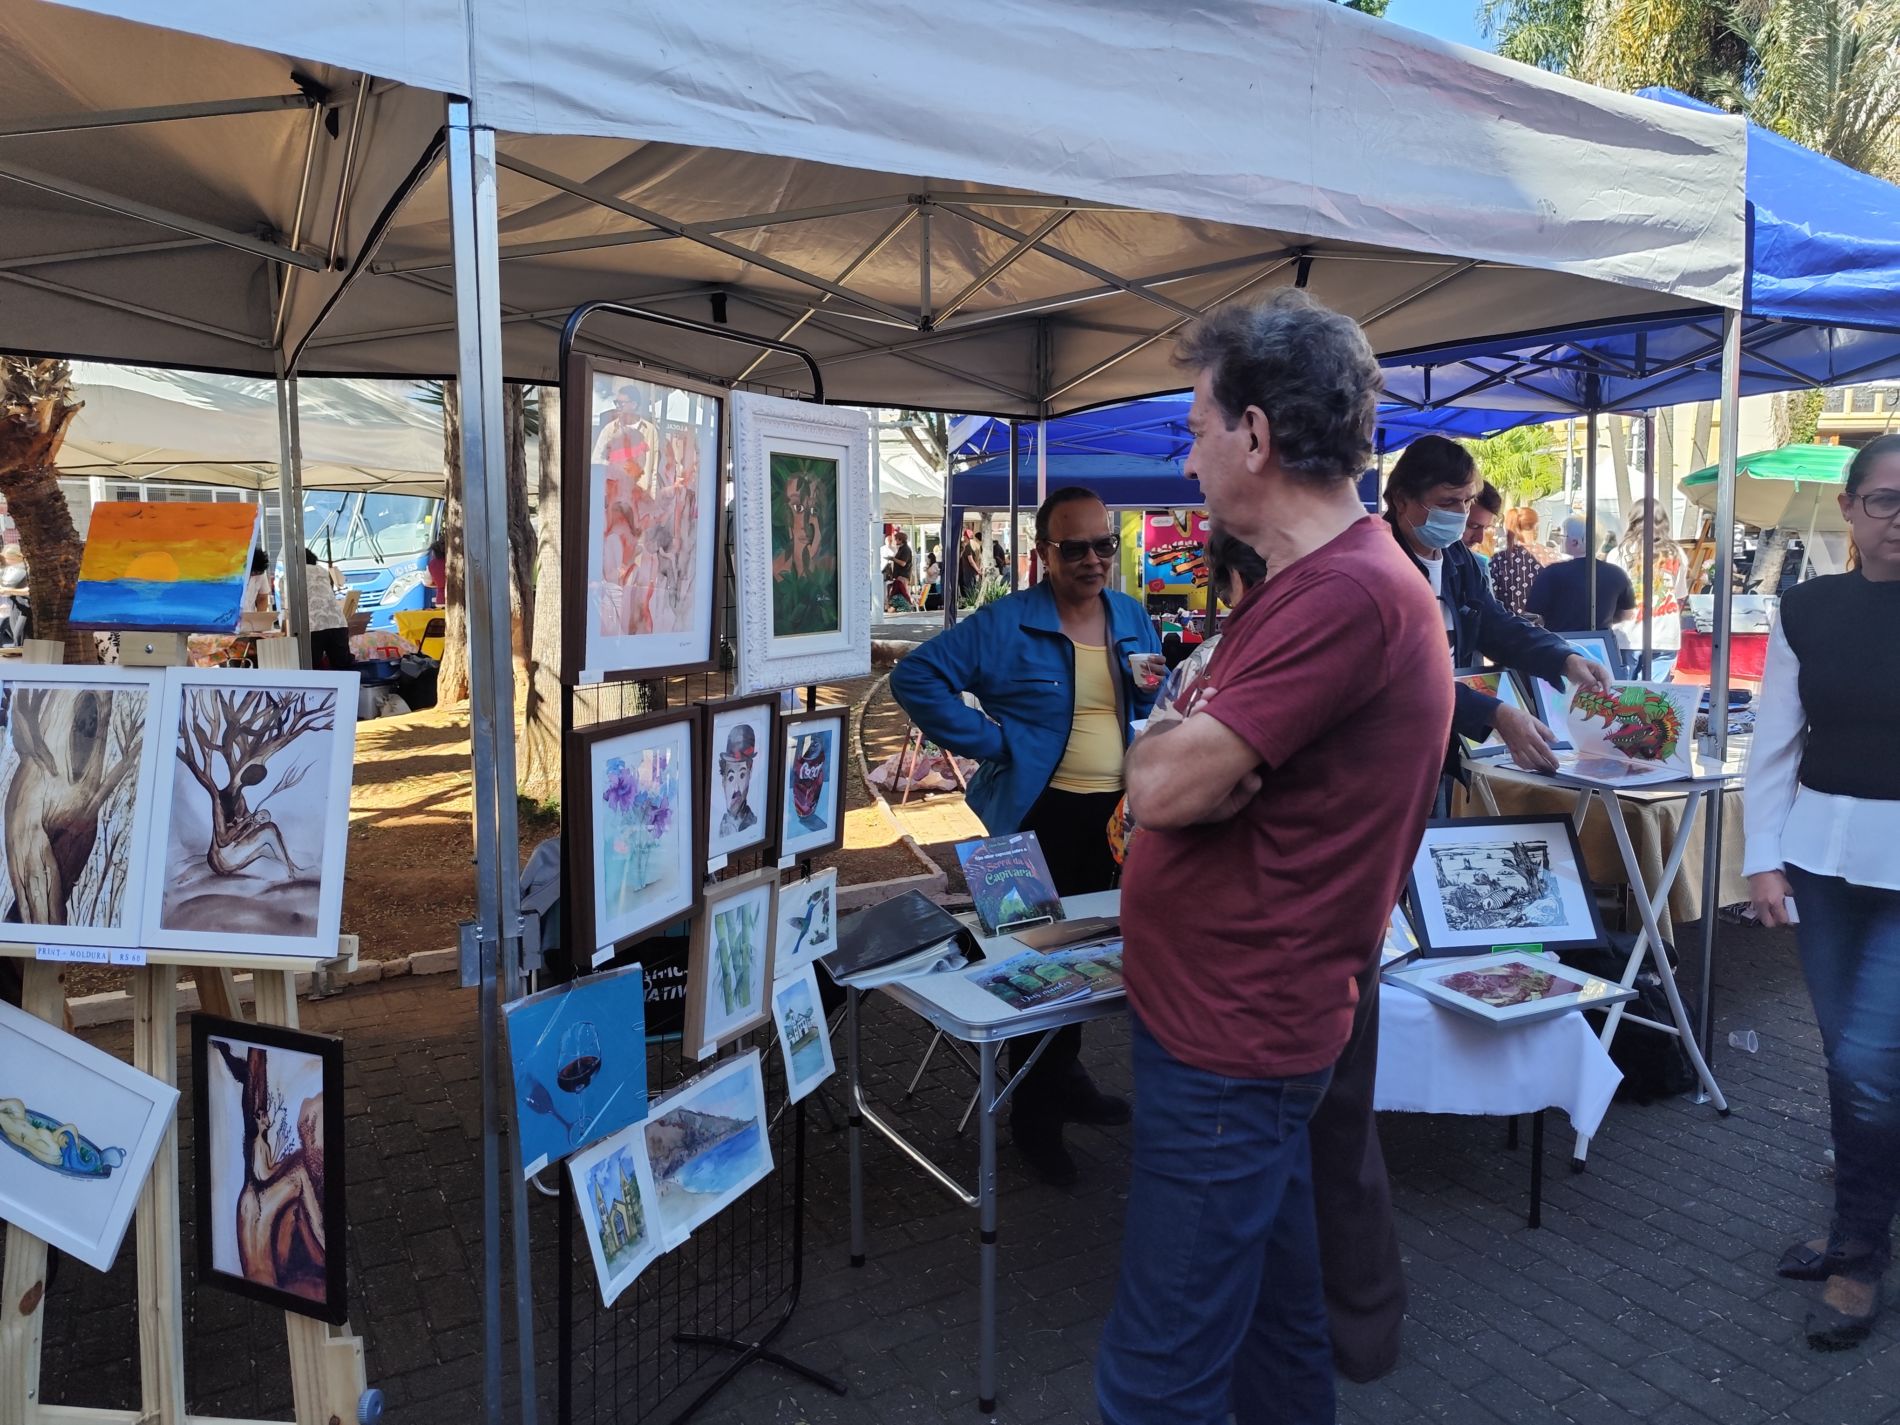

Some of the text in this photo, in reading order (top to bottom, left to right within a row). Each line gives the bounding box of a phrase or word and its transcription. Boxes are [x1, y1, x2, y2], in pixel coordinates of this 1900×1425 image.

[986, 856, 1025, 872] Serra da
[985, 868, 1033, 886] Capivara
[38, 947, 60, 957] PRINT
[70, 950, 106, 960] MOLDURA
[131, 954, 141, 962] 60
